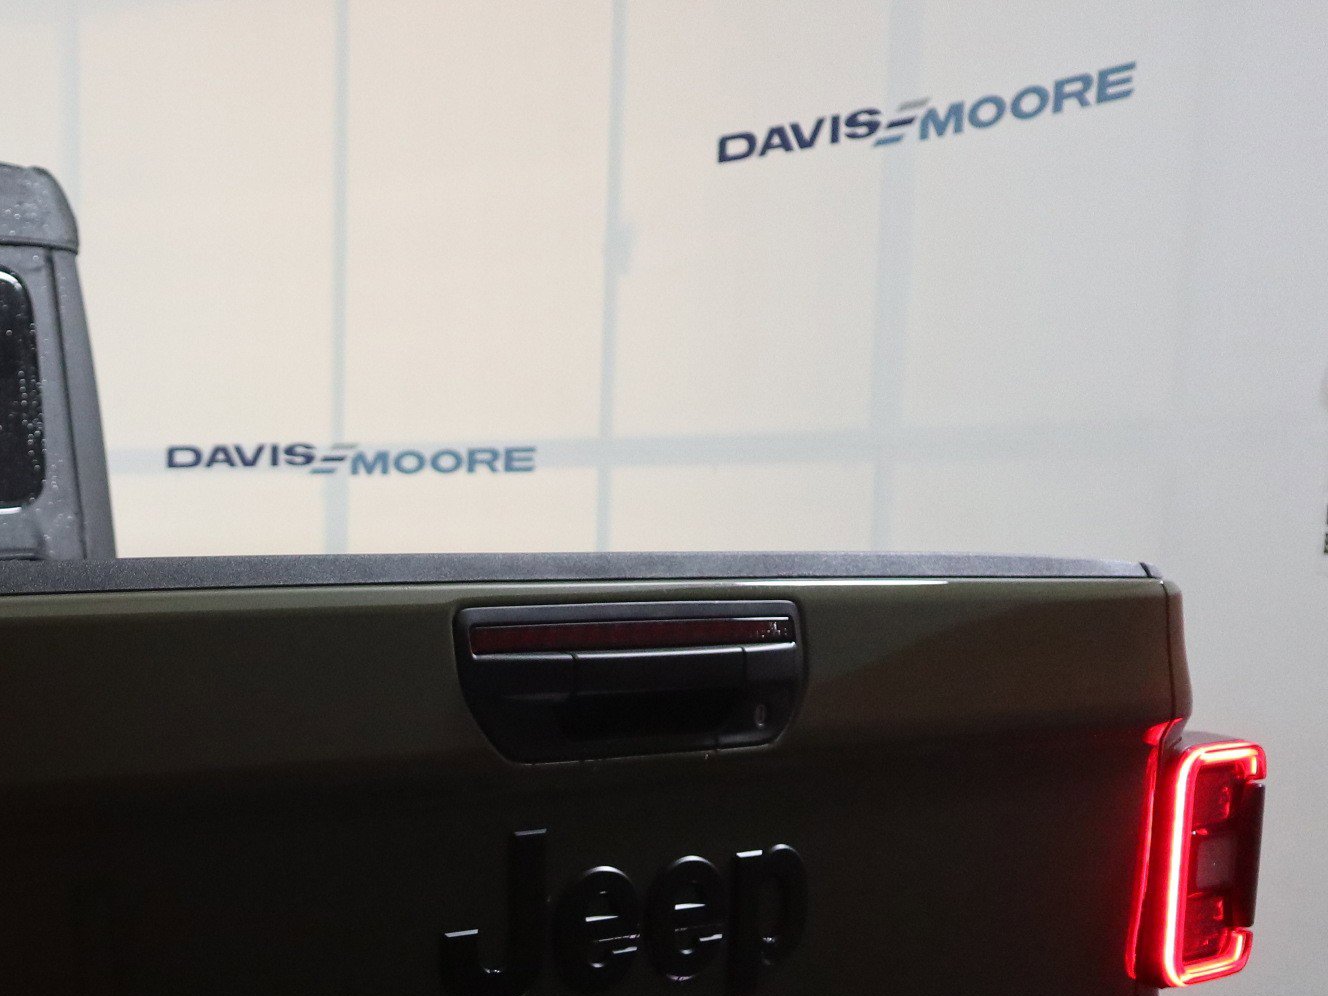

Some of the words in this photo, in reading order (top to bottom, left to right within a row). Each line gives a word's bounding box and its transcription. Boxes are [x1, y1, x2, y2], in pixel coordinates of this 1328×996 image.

[717, 109, 881, 163] DAVIS
[919, 61, 1137, 141] MOORE
[165, 442, 315, 469] DAVIS
[351, 447, 537, 475] MOORE
